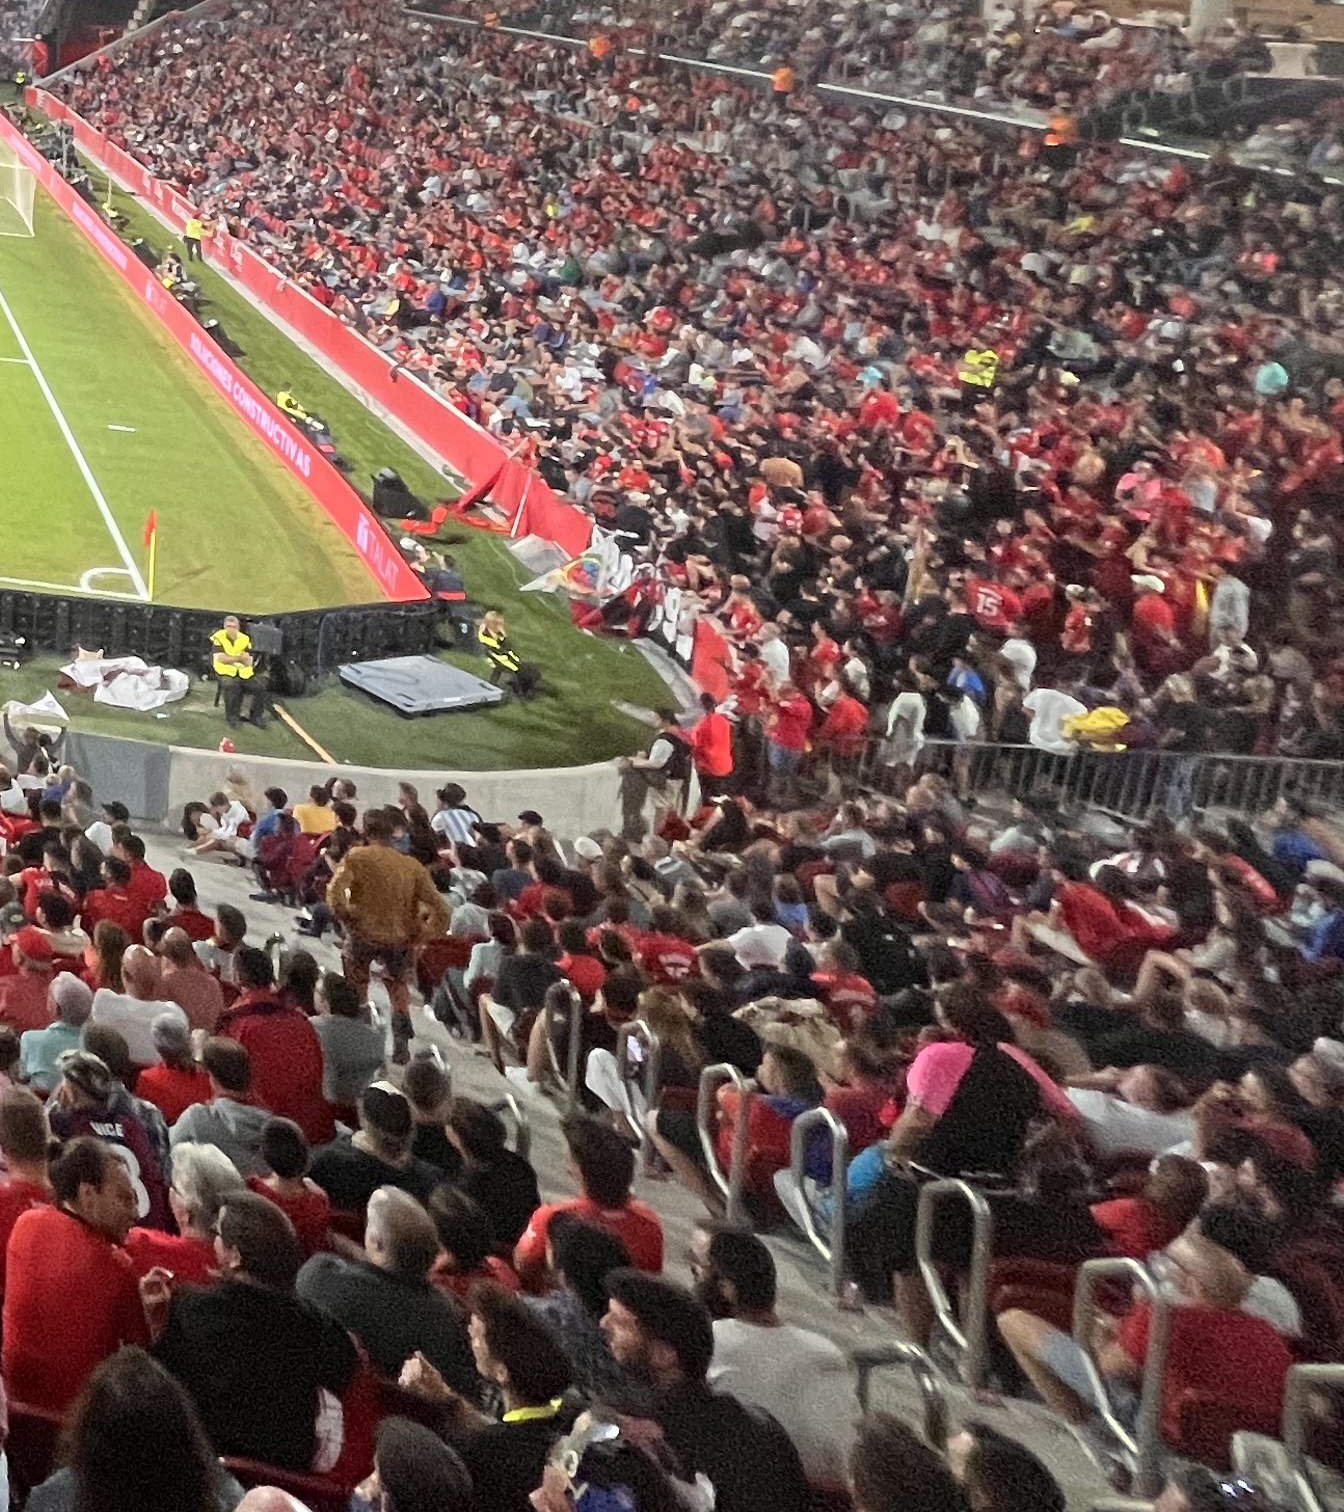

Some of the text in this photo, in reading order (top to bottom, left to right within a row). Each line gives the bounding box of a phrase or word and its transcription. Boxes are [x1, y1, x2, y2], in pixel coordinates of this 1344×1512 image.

[190, 332, 311, 478] SOLUCIONES CONSTRUCTIVAS
[366, 540, 399, 592] TALAT
